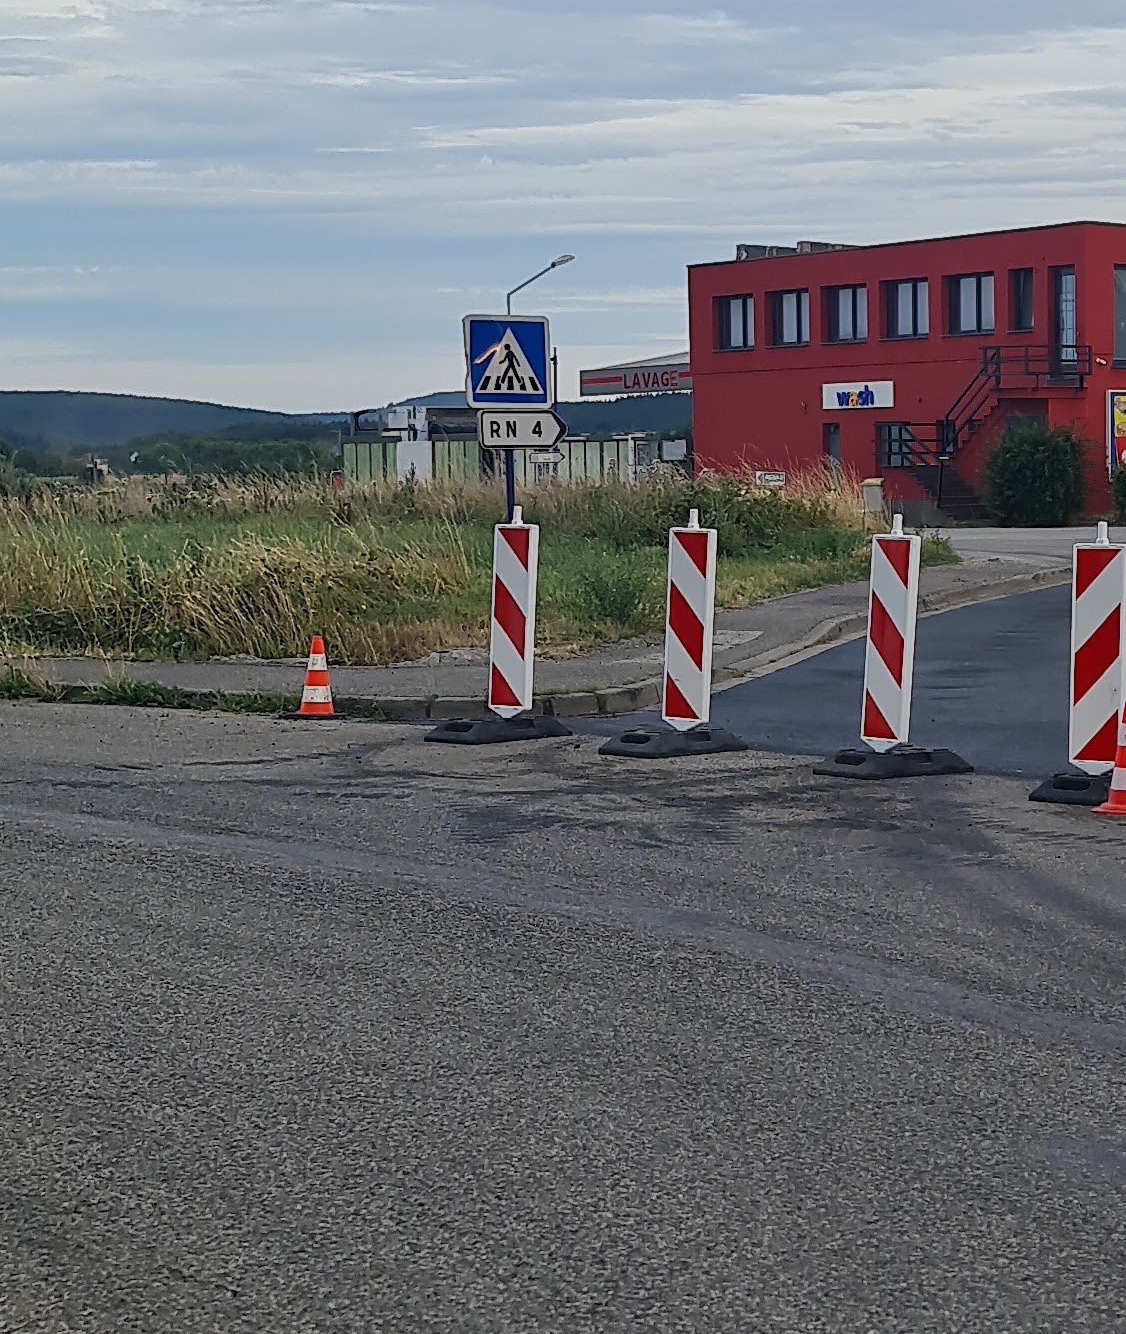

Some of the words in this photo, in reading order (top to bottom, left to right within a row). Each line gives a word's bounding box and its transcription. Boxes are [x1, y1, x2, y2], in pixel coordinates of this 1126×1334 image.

[623, 370, 679, 389] LAVAGE
[836, 384, 875, 406] wash
[490, 420, 517, 438] RN
[531, 420, 543, 438] 4
